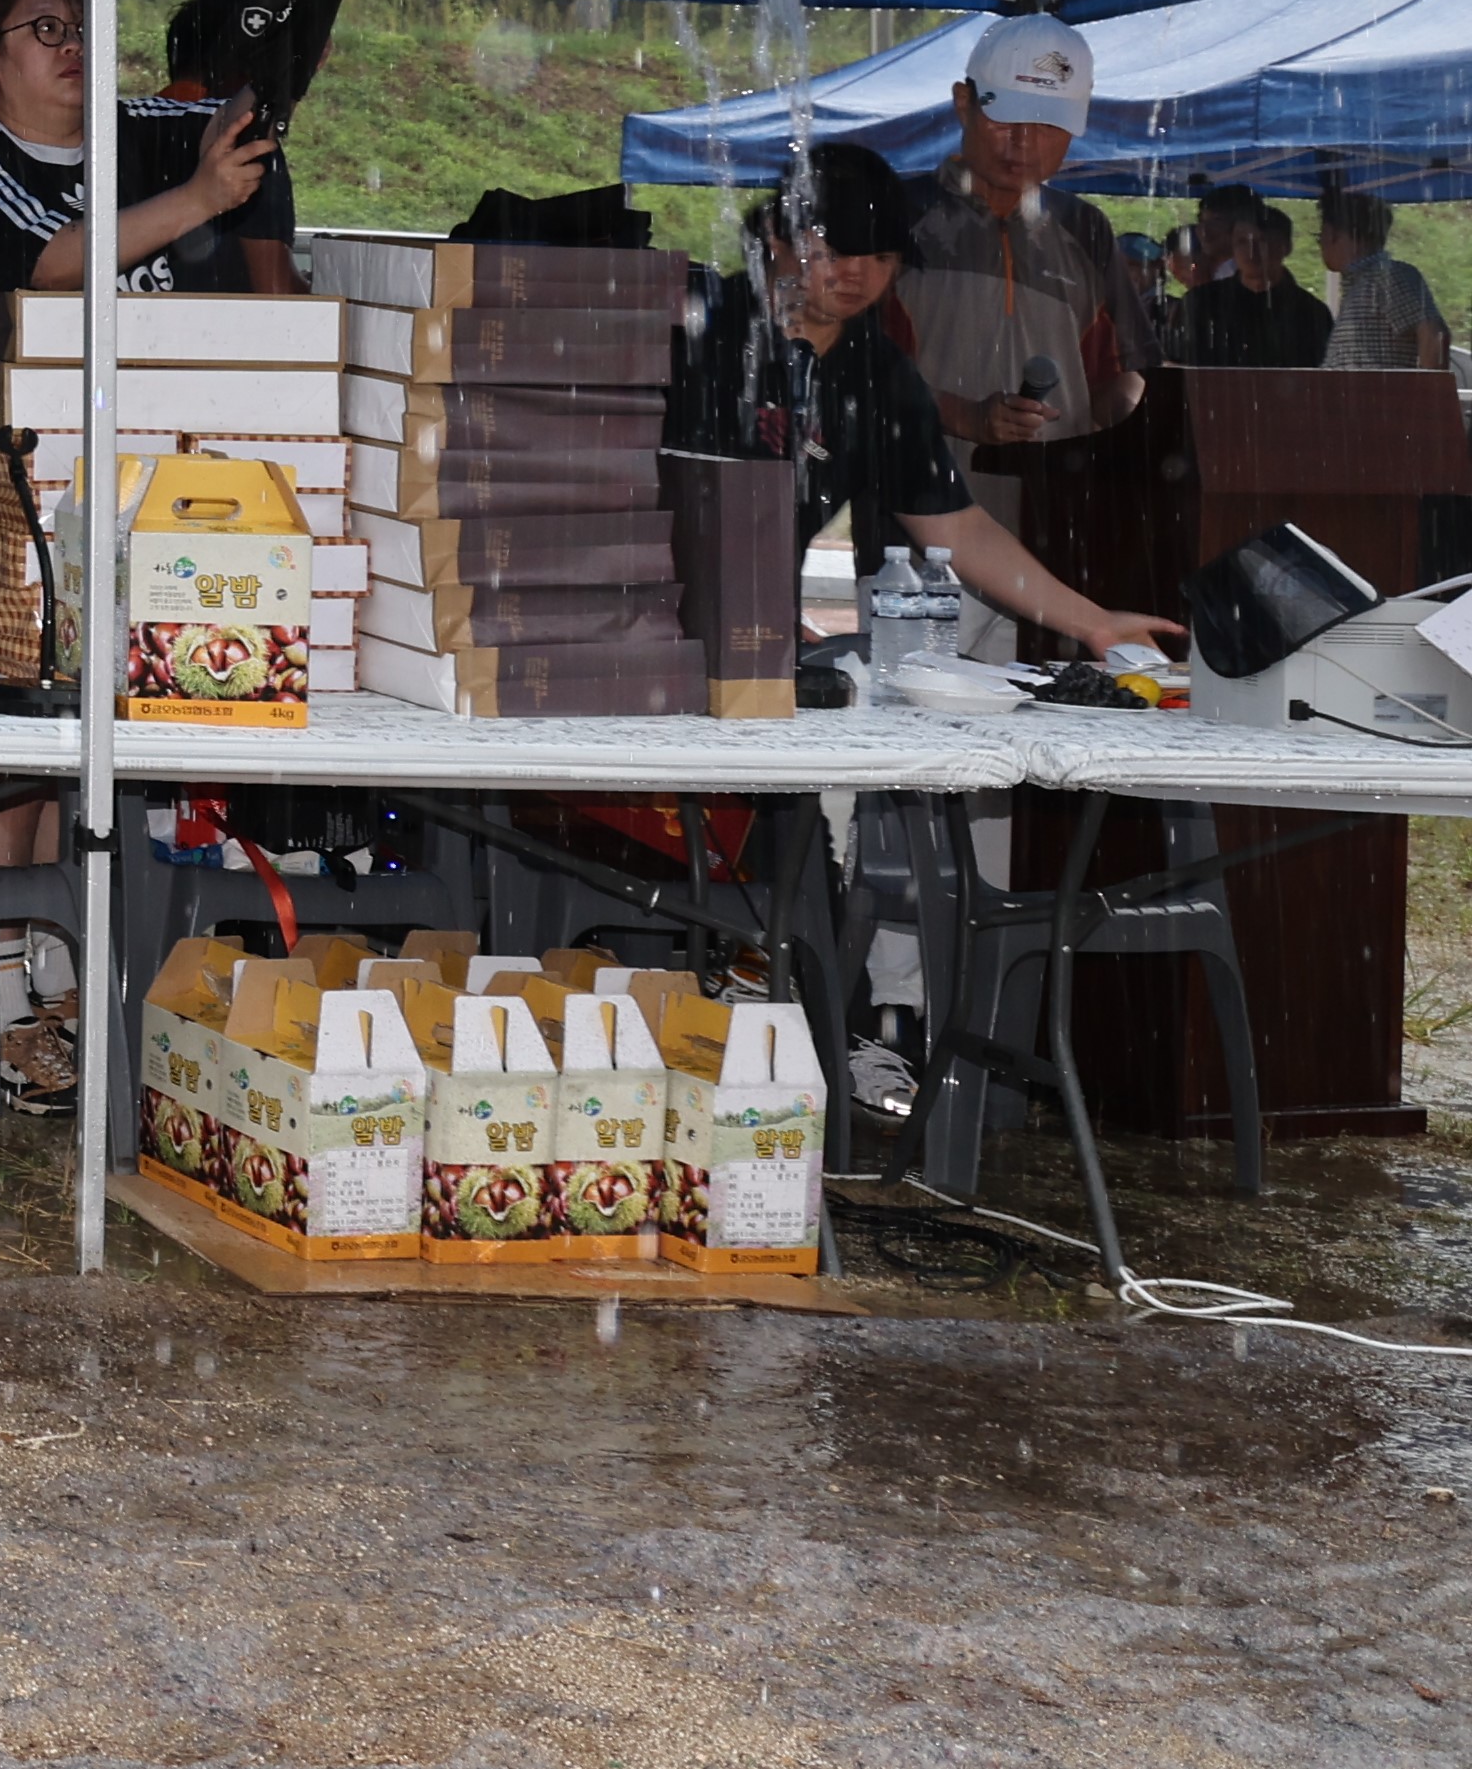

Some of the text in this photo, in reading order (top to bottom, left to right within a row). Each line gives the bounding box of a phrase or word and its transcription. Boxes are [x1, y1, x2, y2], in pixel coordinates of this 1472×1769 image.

[194, 574, 263, 609] 알밤
[268, 706, 295, 721] 4kg
[167, 1051, 202, 1093] 알밤
[247, 1087, 284, 1133] 알밤
[351, 1114, 406, 1146] 알밤
[485, 1120, 538, 1152] 알밤
[594, 1117, 646, 1149] 알밤
[752, 1128, 806, 1160] 알밤
